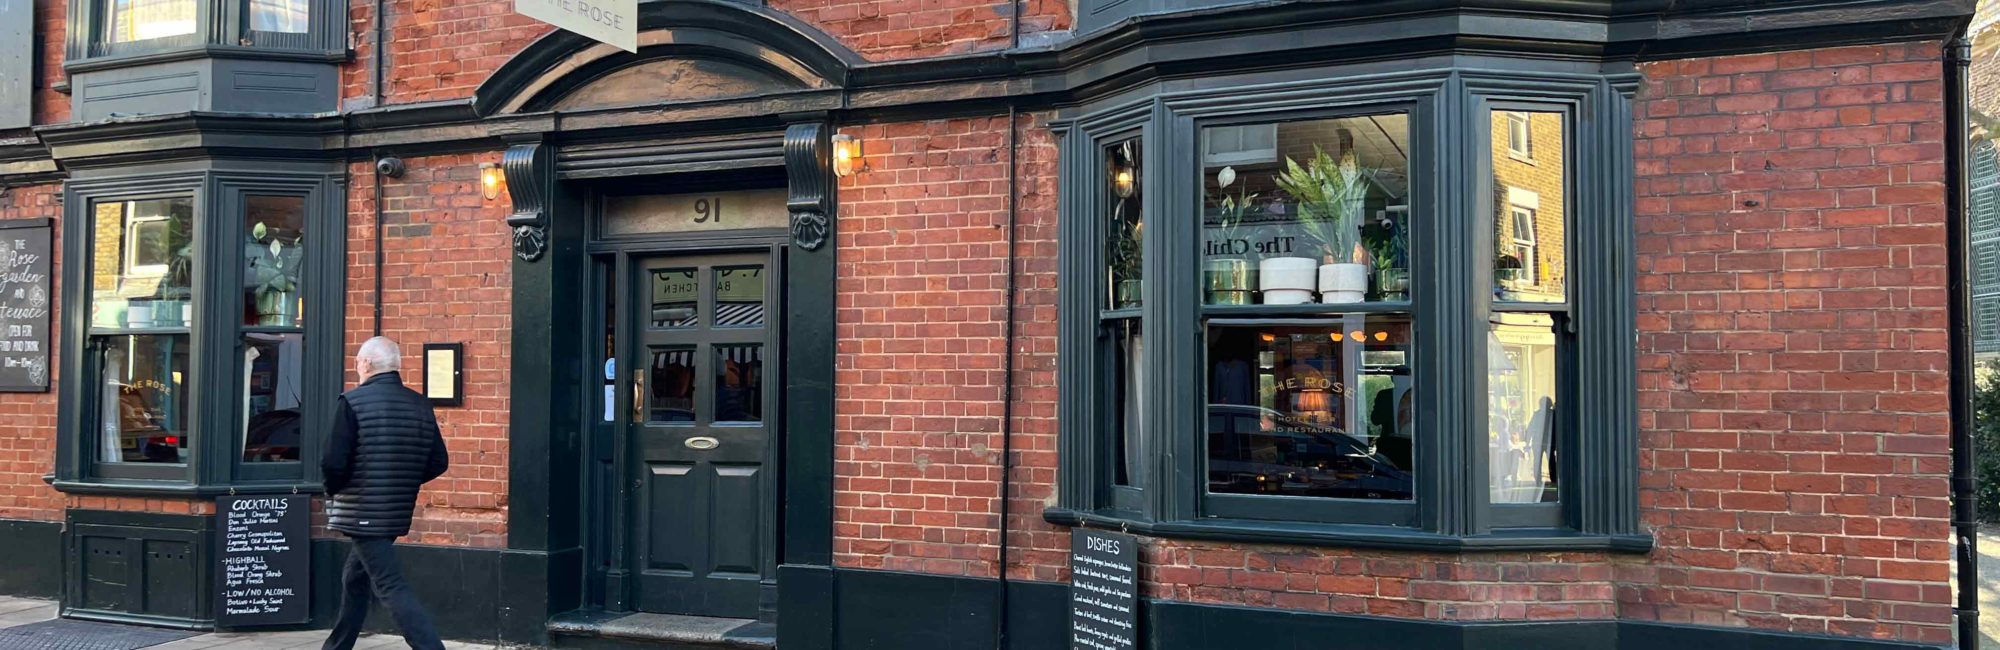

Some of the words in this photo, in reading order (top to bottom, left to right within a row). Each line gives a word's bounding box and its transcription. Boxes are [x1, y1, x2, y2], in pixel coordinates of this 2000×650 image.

[577, 1, 624, 31] ROSE
[693, 198, 721, 223] 91
[14, 239, 26, 250] THE
[9, 250, 39, 267] Rose
[0, 264, 45, 293] garden
[146, 380, 172, 396] ROSE
[1304, 376, 1357, 400] ROSE
[232, 498, 288, 511] COCKTAILS
[228, 511, 246, 519] Blood
[1087, 535, 1120, 555] DISHES
[264, 588, 295, 596] ALCOHOL
